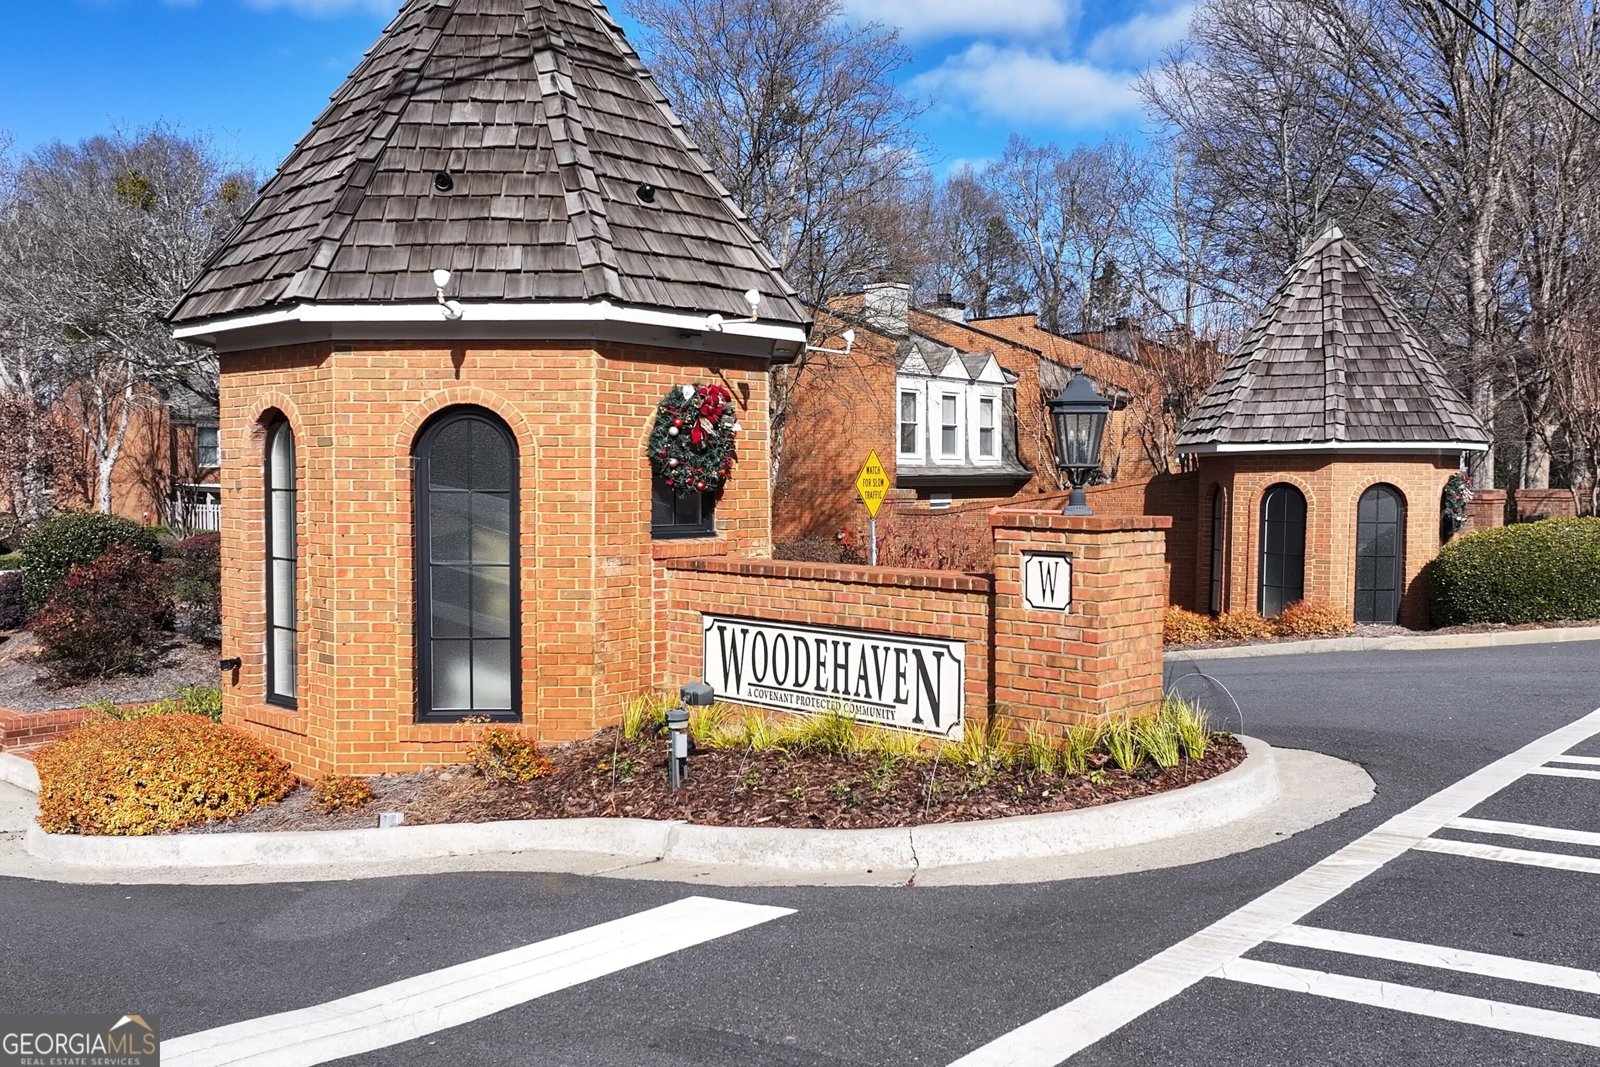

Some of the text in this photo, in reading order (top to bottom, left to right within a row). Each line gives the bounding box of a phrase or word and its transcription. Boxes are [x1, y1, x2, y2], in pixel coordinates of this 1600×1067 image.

[866, 466, 880, 474] WATCH
[863, 479, 884, 487] FOR SLOW
[865, 491, 882, 499] TRAFFIC
[1038, 561, 1059, 603] W
[717, 625, 944, 728] WOODEHAVEN
[748, 688, 896, 720] A COVENANT PROTECTED COMMUNITY
